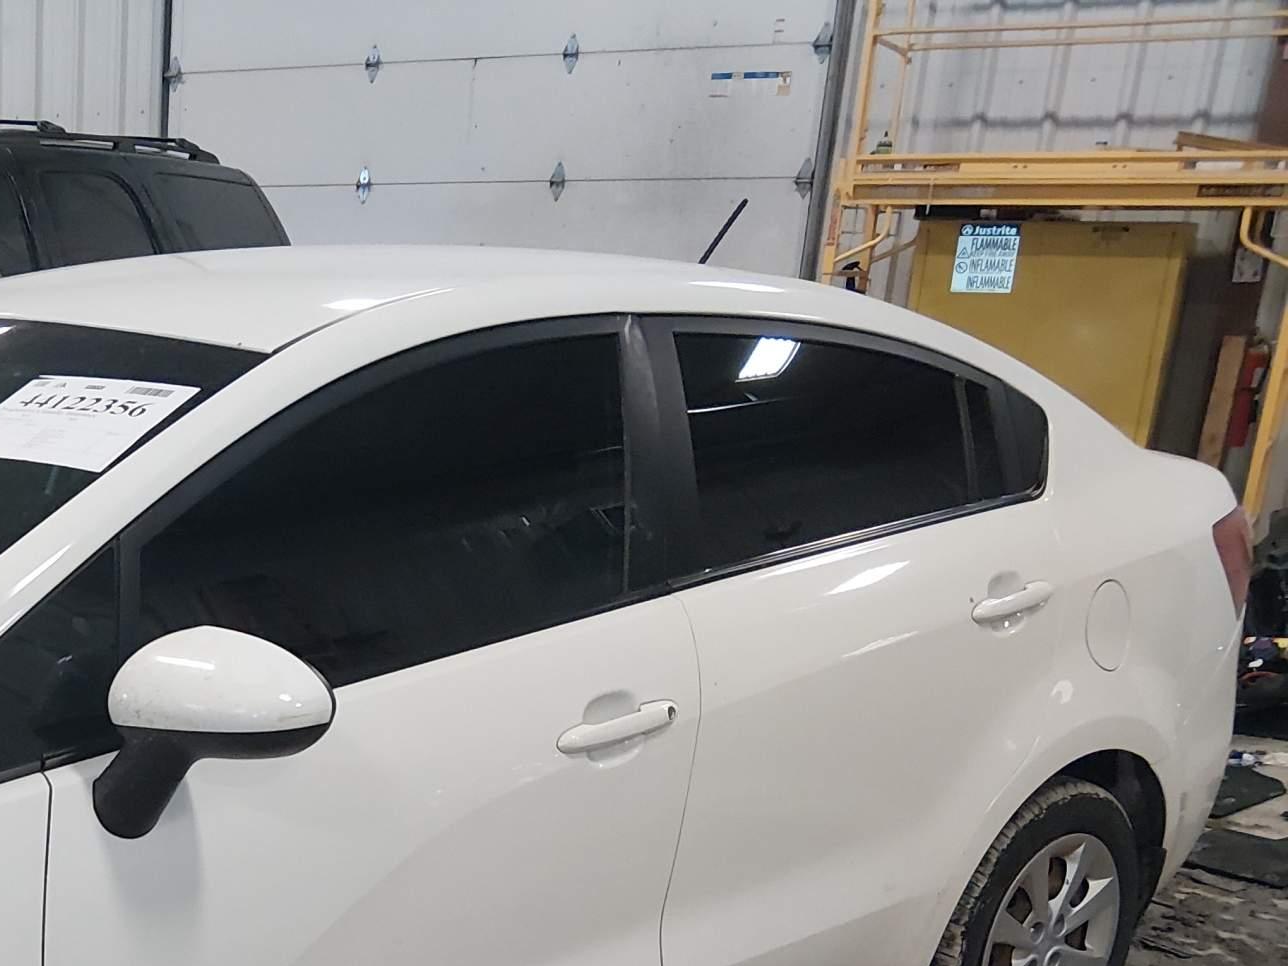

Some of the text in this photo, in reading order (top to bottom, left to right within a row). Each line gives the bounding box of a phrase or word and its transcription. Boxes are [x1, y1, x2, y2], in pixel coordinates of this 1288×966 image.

[973, 225, 1017, 235] Justrite
[971, 237, 1016, 250] FLAMMABLE
[969, 258, 1013, 272] INFLAMABLE
[966, 275, 1011, 289] INFLAMMABLE
[20, 393, 152, 417] 44122356
